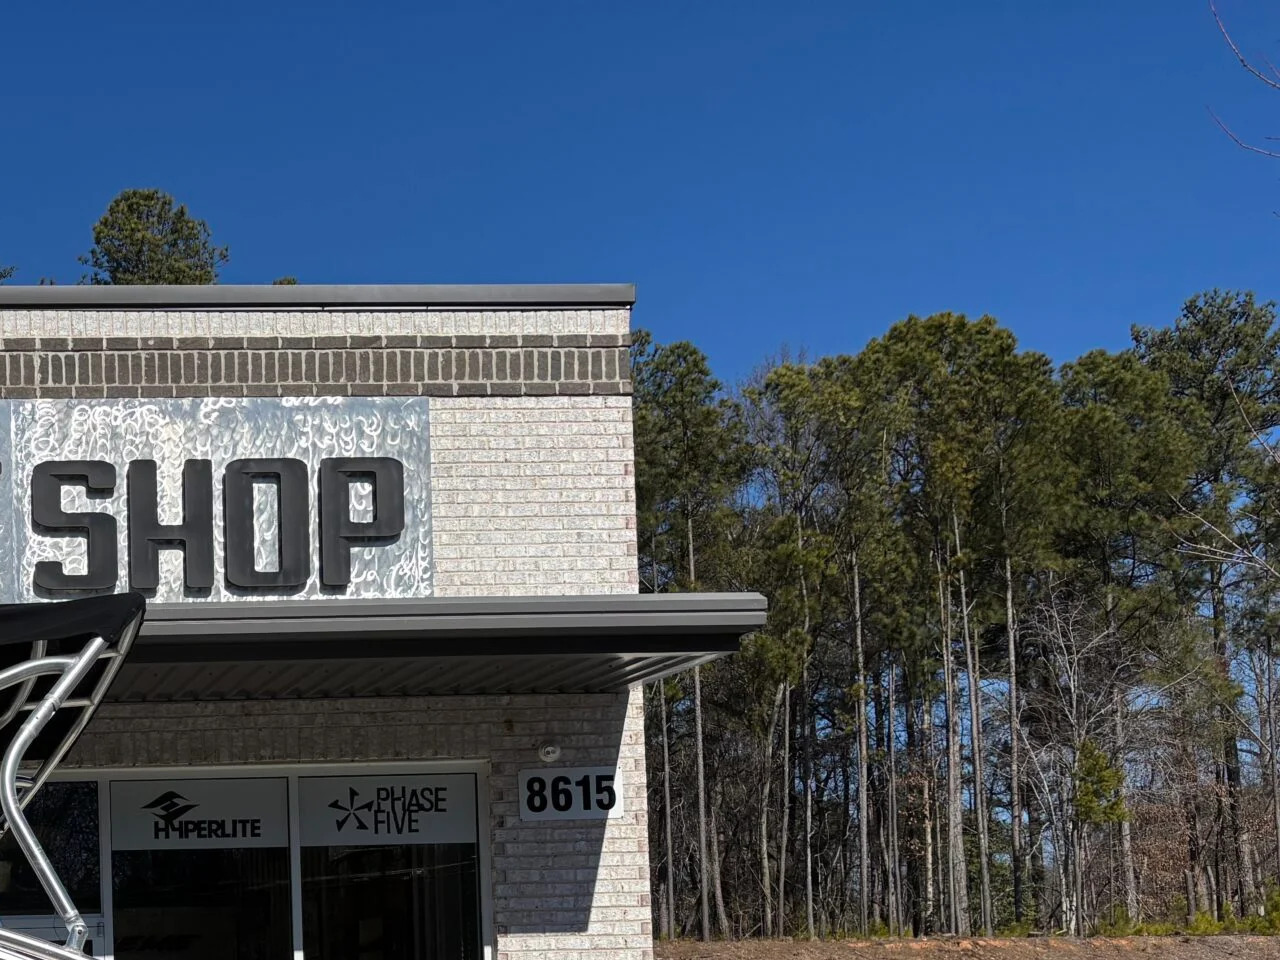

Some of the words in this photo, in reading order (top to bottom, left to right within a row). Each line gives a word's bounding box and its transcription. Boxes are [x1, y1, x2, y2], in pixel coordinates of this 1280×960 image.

[31, 457, 405, 598] SHOP
[375, 786, 448, 813] PHASE
[526, 774, 617, 813] 8615
[153, 818, 261, 840] HYPERLITE
[373, 809, 420, 835] FIVE
